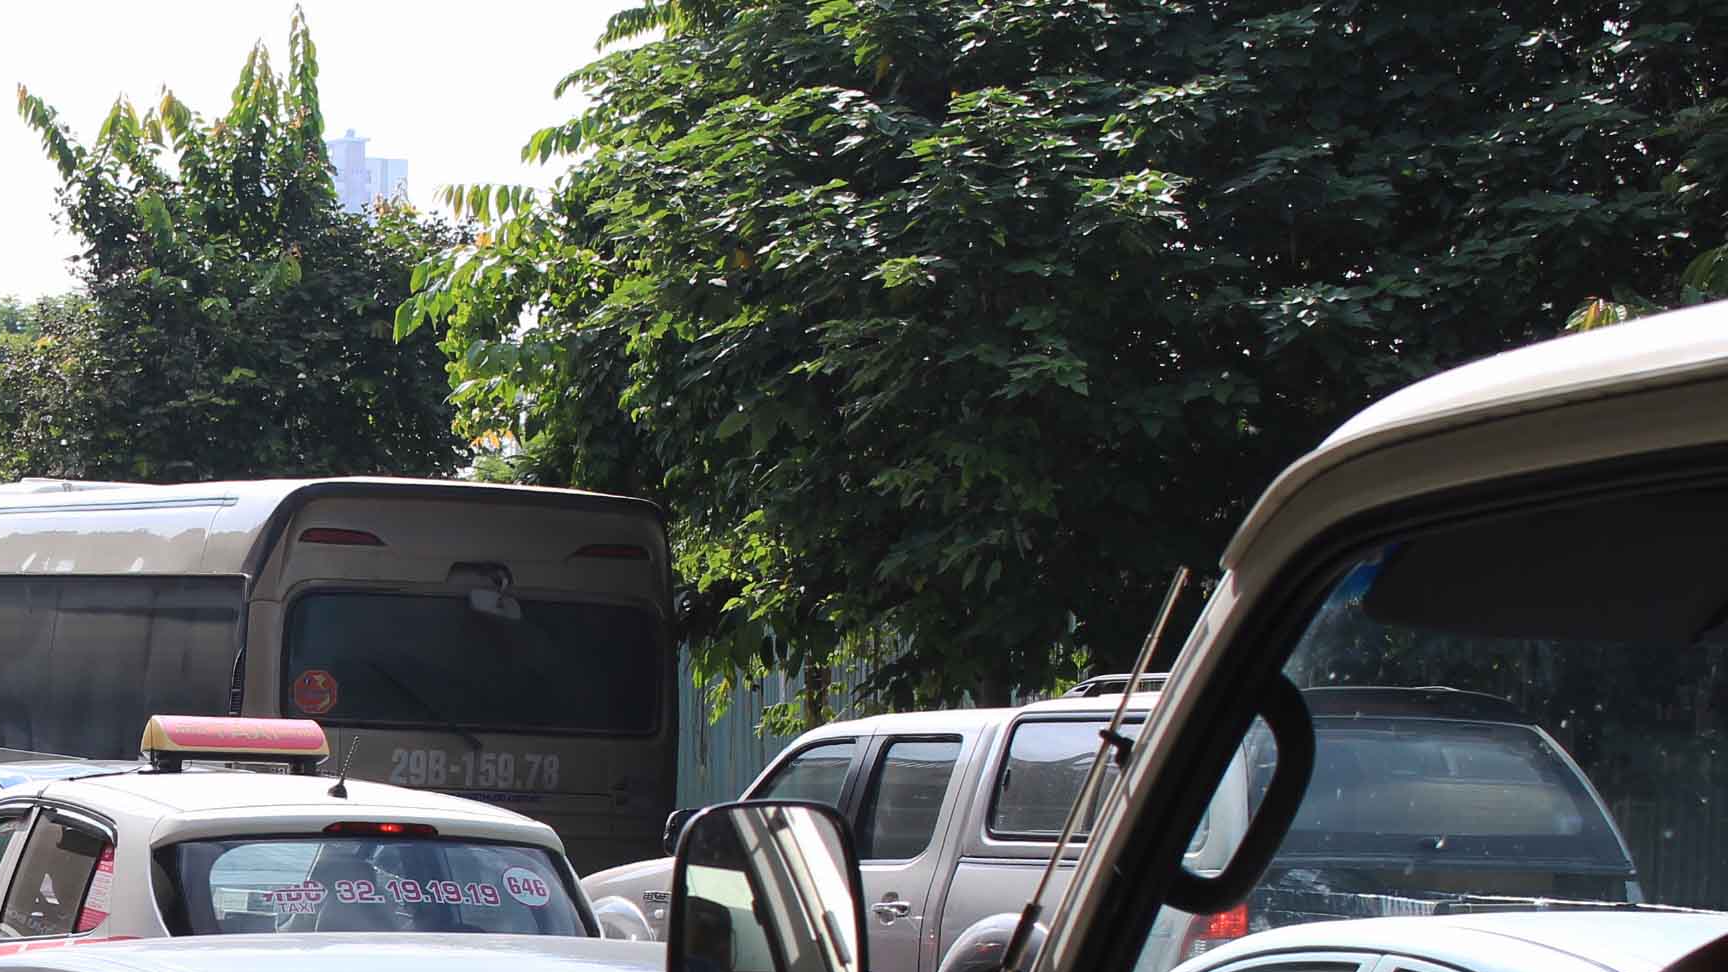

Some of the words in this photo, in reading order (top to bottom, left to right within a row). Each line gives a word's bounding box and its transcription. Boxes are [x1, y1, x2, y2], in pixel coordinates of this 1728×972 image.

[390, 748, 561, 790] 29B-159.78
[507, 876, 549, 898] 646
[279, 902, 316, 913] TAXI
